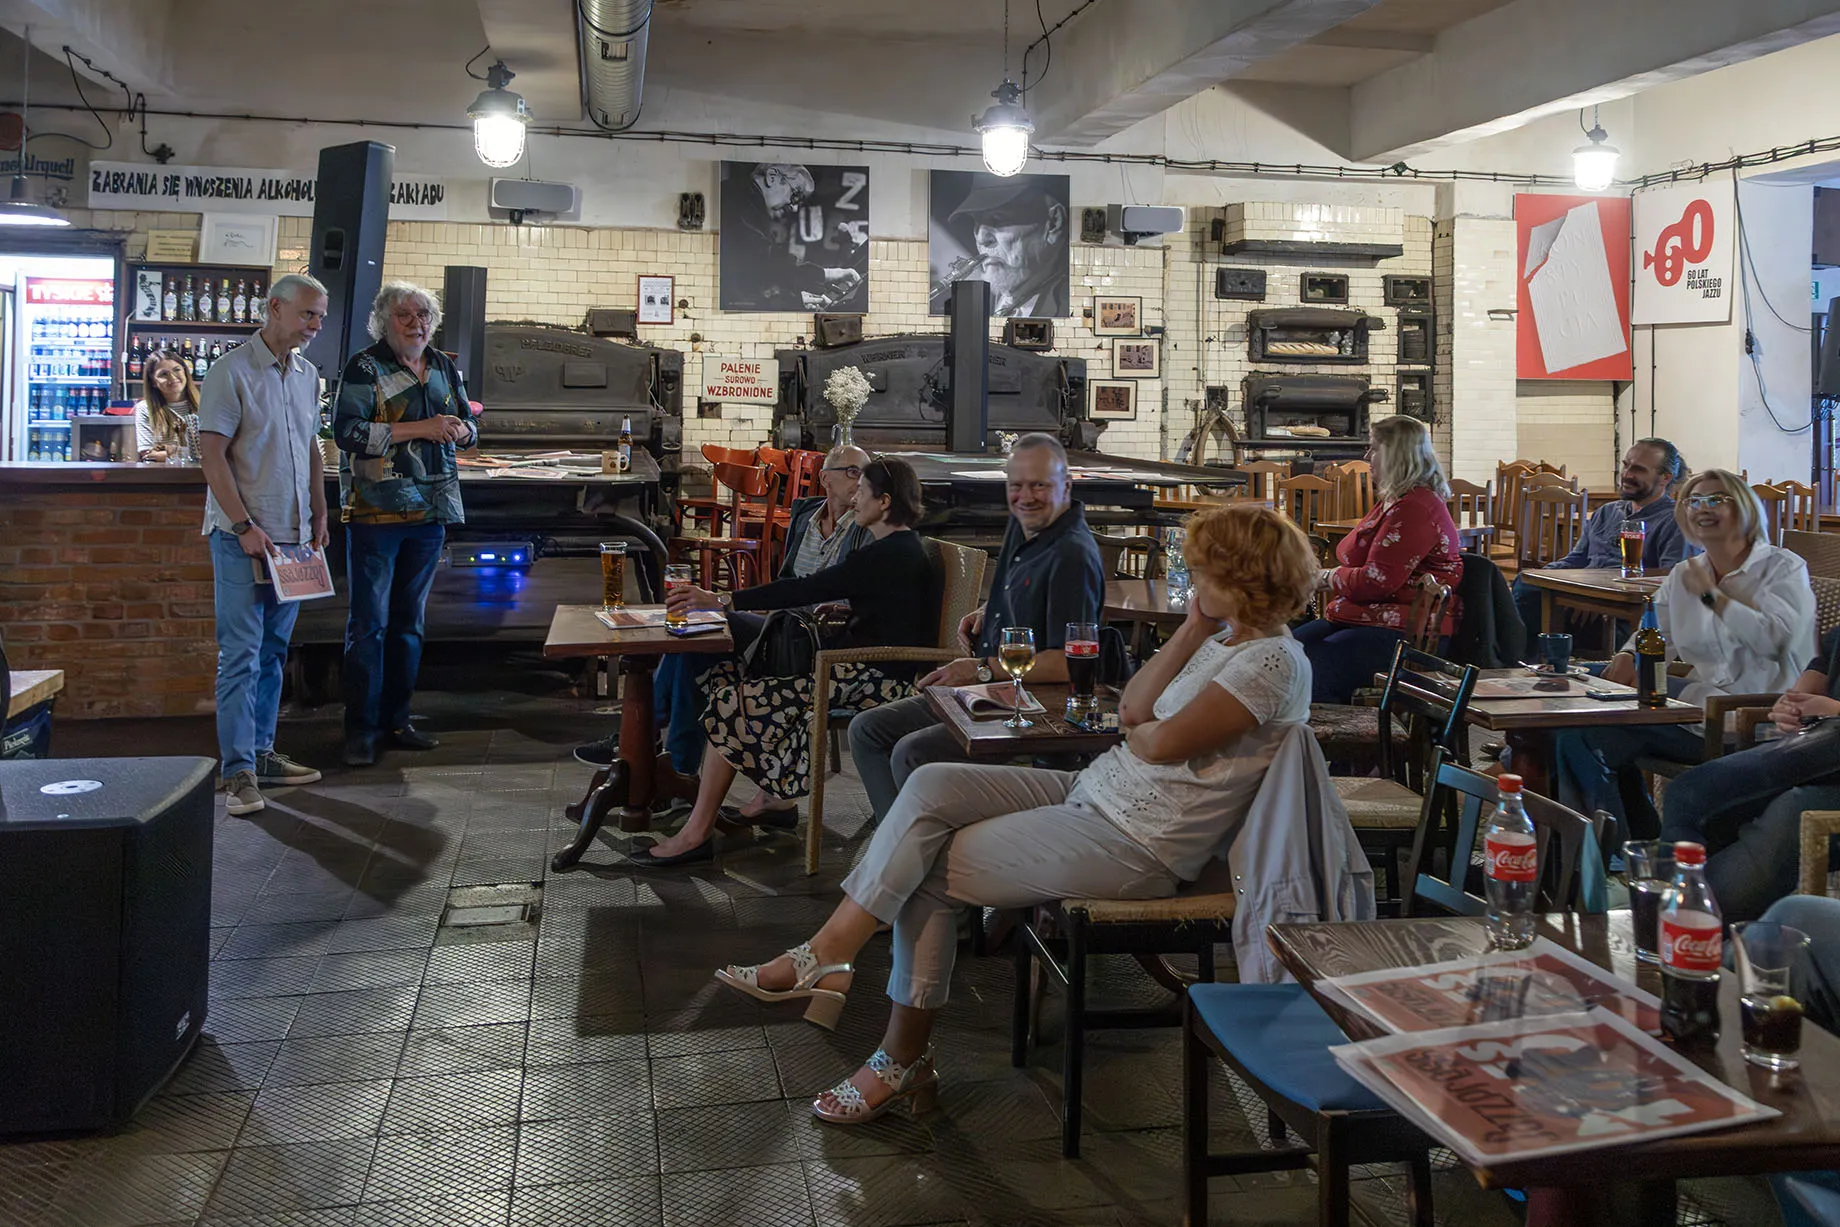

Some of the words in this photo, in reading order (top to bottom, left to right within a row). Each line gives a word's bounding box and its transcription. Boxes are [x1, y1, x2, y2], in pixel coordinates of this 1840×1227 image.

[92, 170, 158, 195] ZABRANIA
[162, 174, 180, 202] SIĘ
[185, 176, 253, 199] WNOSZENIA
[257, 178, 318, 202] ALKOHOL
[1687, 269, 1697, 280] 60
[1697, 269, 1709, 279] LAT
[1686, 277, 1722, 289] POLSKIEGO
[1702, 288, 1721, 299] JAZZU
[720, 362, 761, 374] PALENIE
[725, 375, 756, 385] SUROWO
[706, 385, 774, 399] WZBRONIONE
[1495, 847, 1538, 870] Coca-C
[1673, 932, 1723, 957] Coca-C
